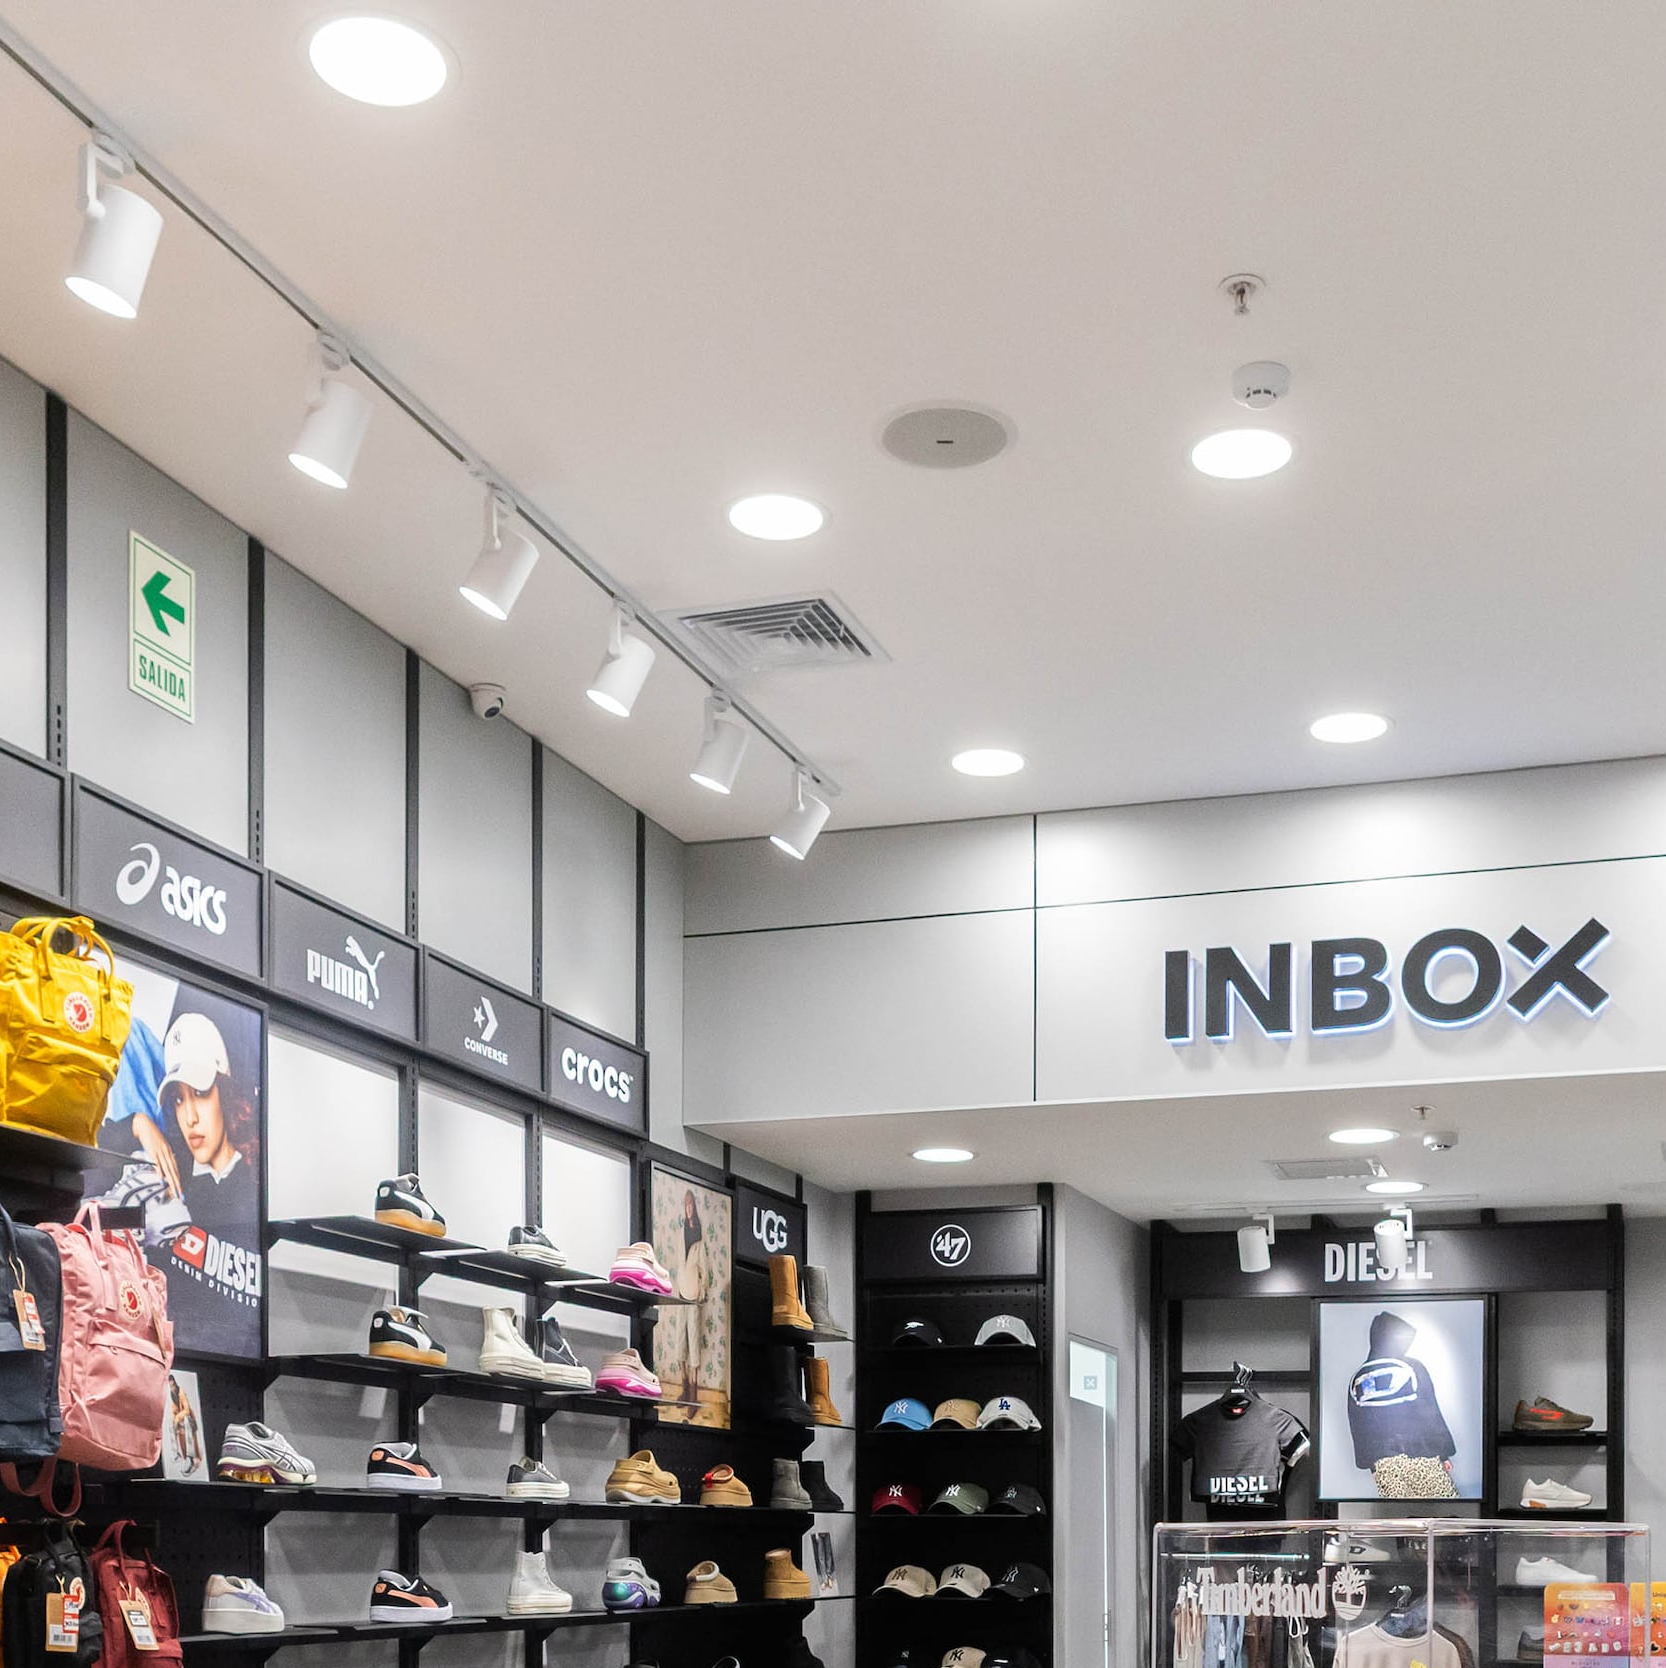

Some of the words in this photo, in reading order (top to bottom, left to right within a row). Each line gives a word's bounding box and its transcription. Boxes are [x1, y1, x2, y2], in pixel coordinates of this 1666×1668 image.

[138, 654, 187, 704] SALIDA
[162, 863, 228, 935] asics
[306, 948, 369, 1006] PUMA
[1164, 916, 1612, 1044] INBOX
[464, 1036, 508, 1066] CONVERSE
[561, 1047, 631, 1104] crocs
[753, 1206, 788, 1253] UGG
[171, 1256, 202, 1282] DENIM
[209, 1279, 258, 1308] DIVISIO
[1210, 1476, 1269, 1493] DIESEL
[1197, 1566, 1327, 1619] Timberland
